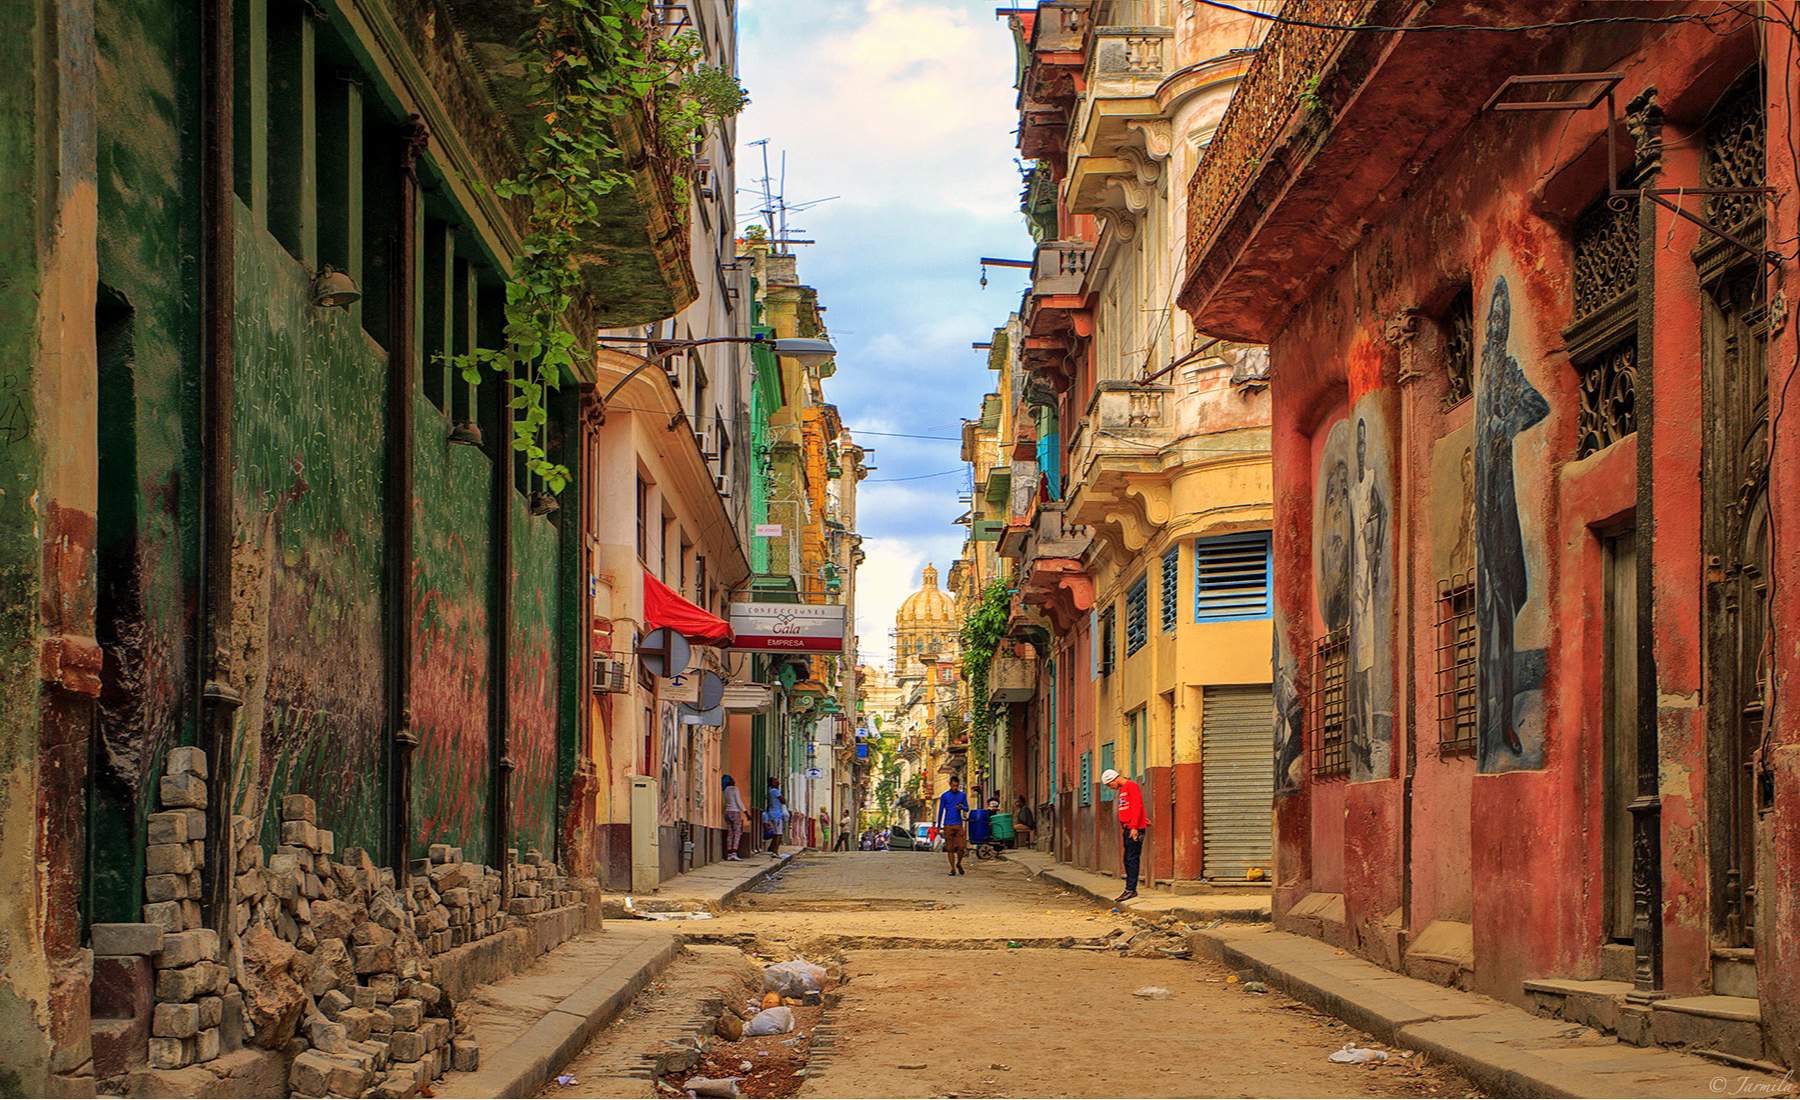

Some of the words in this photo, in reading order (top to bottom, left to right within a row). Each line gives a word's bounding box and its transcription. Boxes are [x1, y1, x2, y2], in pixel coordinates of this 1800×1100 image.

[748, 607, 826, 615] CONFECCIONES
[773, 622, 801, 634] Gala
[767, 639, 805, 647] EMPRESA
